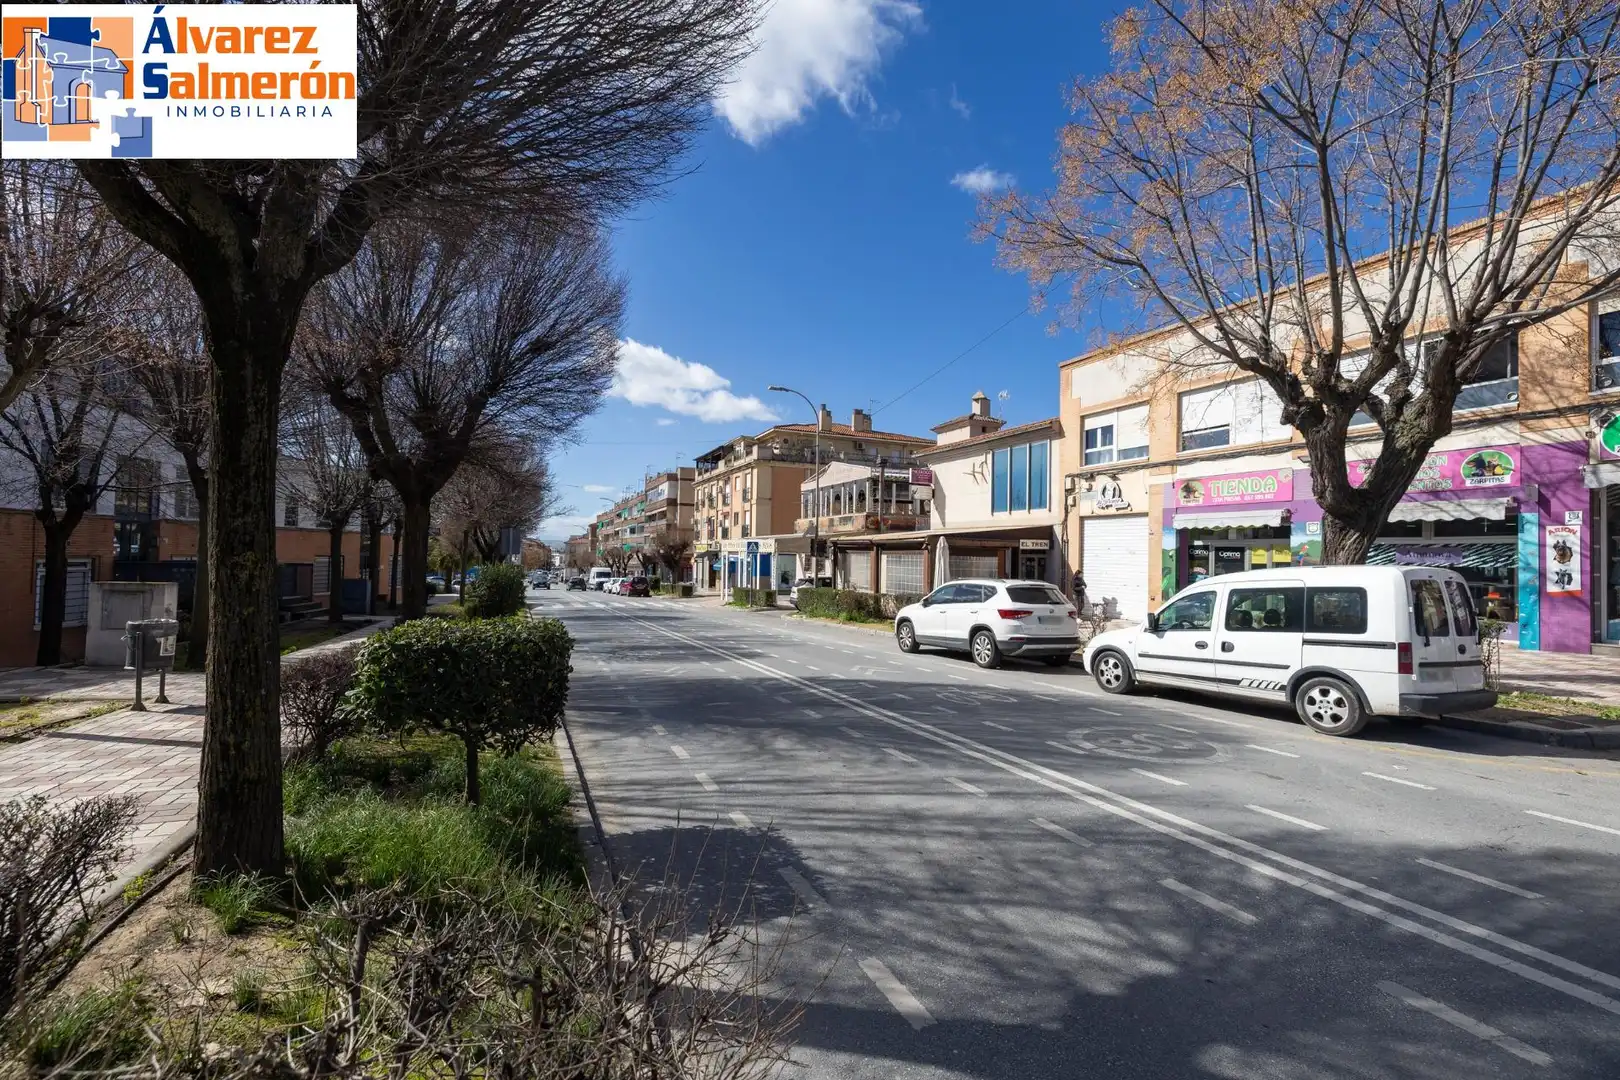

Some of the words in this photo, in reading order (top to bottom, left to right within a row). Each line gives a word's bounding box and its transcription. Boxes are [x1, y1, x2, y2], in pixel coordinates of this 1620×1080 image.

[1469, 476, 1506, 485] ZARPITAS
[1210, 475, 1278, 497] TIENDA
[1548, 526, 1578, 536] ARION
